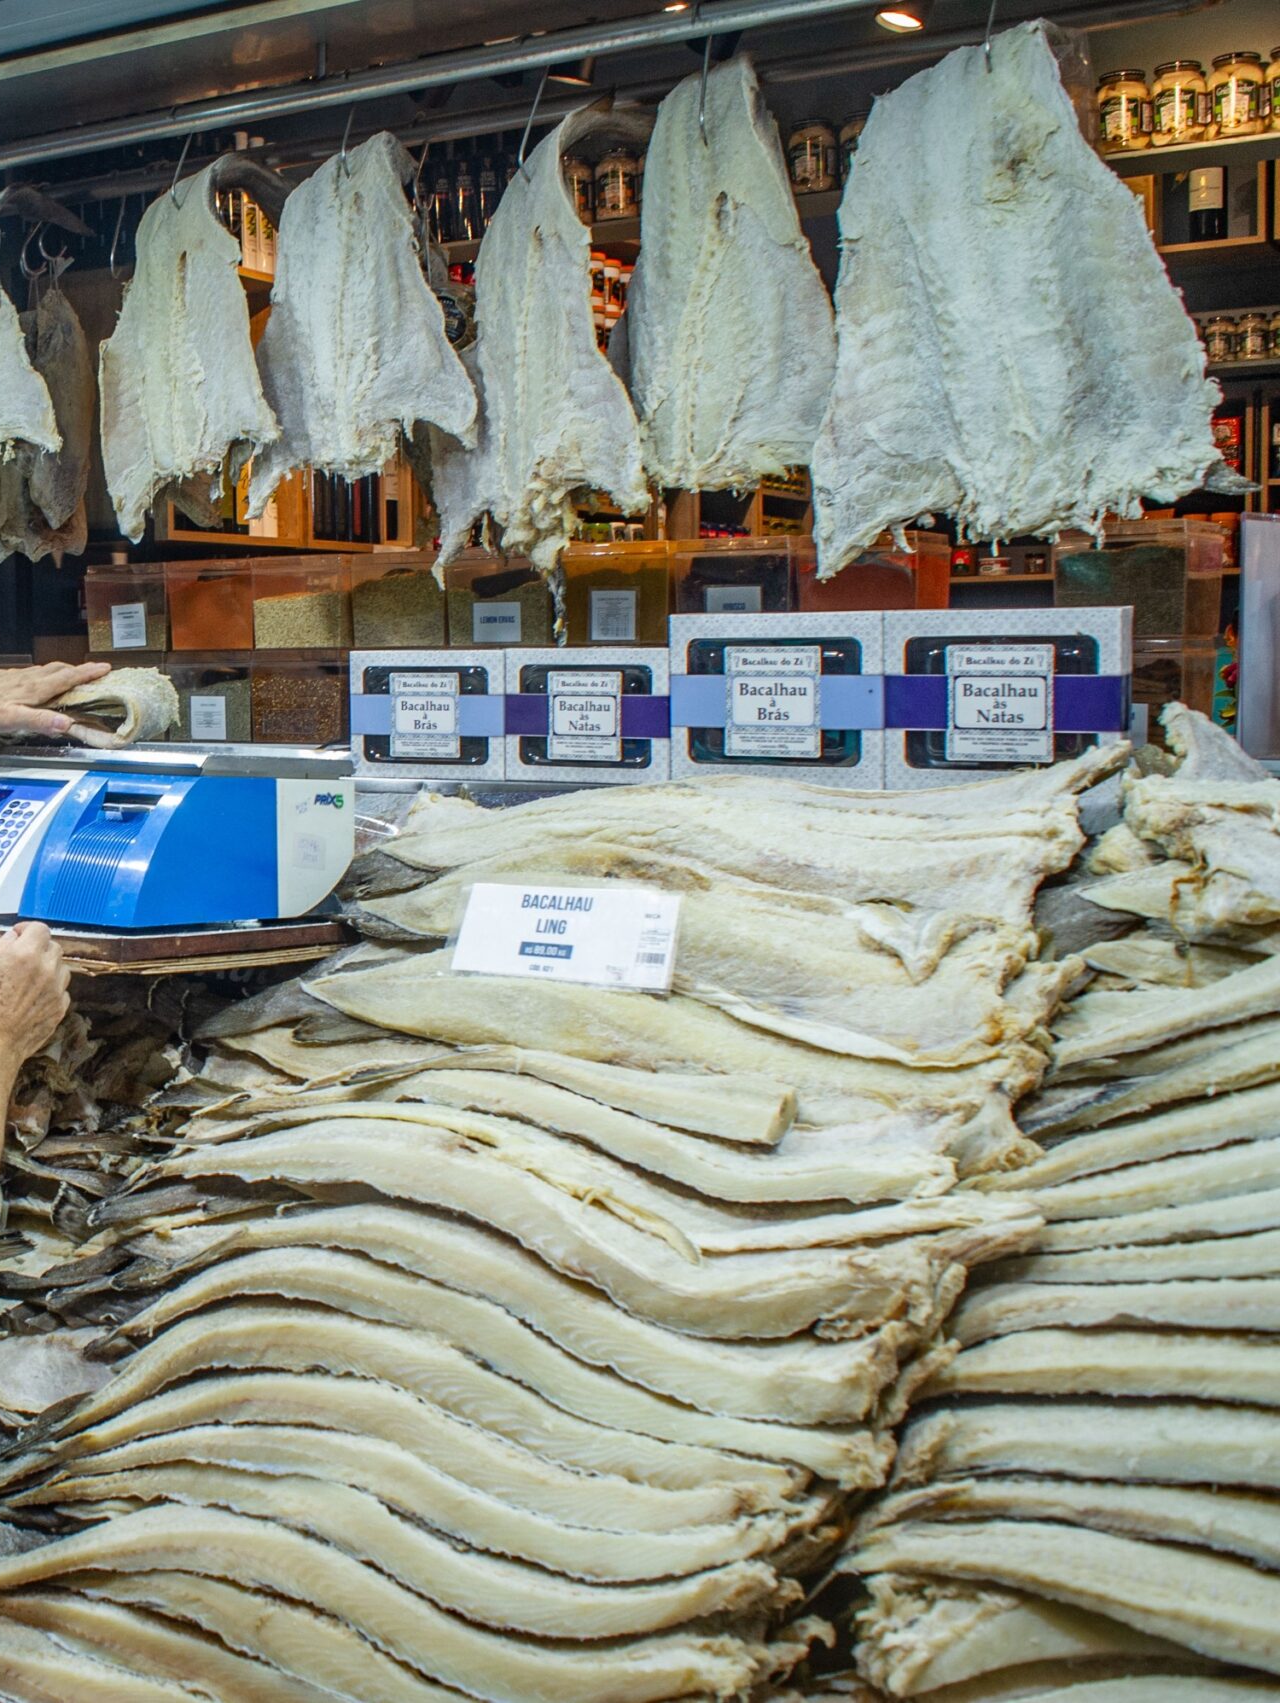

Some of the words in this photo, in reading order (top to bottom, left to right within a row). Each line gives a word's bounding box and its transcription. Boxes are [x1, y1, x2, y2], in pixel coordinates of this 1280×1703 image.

[739, 683, 807, 696] Bacalhau
[961, 683, 1038, 698] Bacalhau
[401, 700, 450, 711] Bacalhau
[559, 700, 610, 712] Bacalhau
[757, 708, 790, 721] Brás
[976, 709, 1025, 724] Natas
[413, 719, 438, 730] Brás
[568, 720, 601, 731] Natas
[521, 894, 594, 912] BACALHAU
[535, 918, 568, 935] LING
